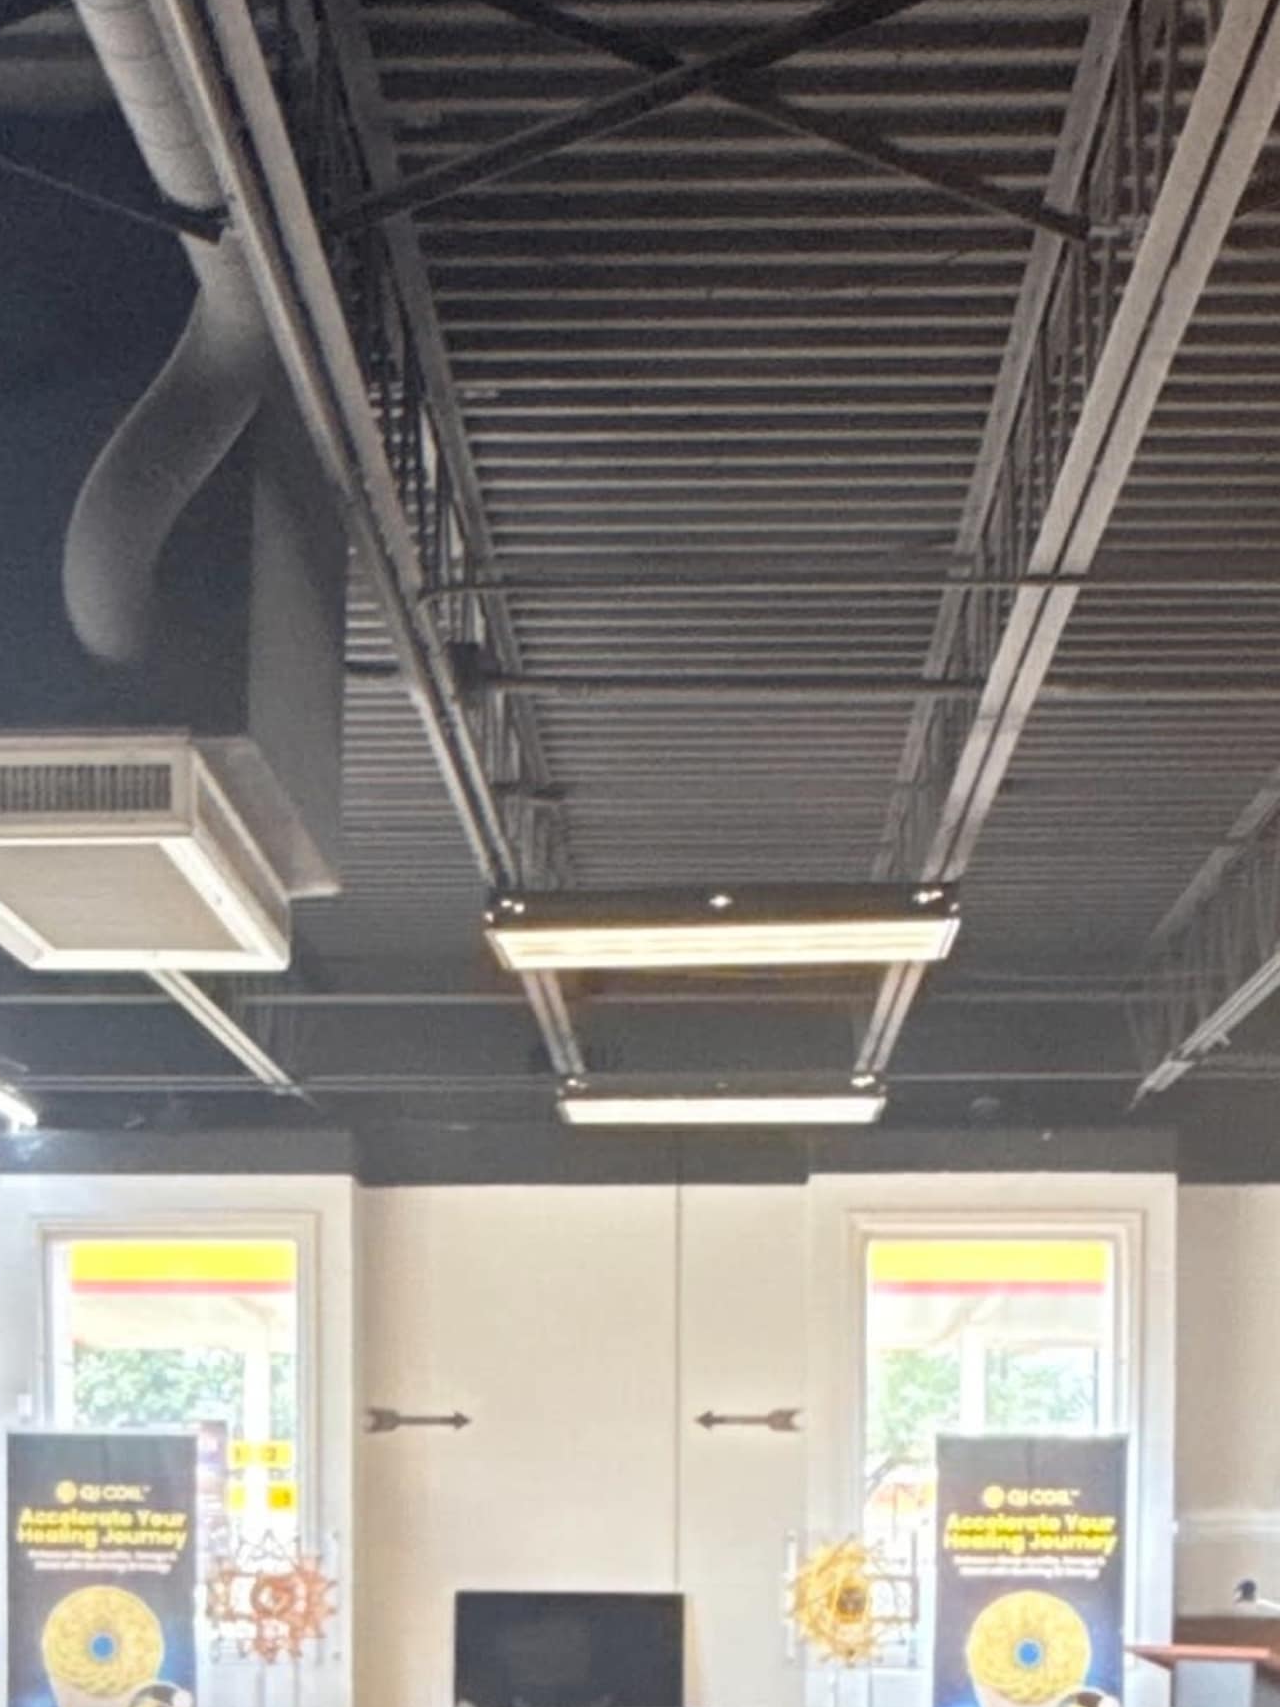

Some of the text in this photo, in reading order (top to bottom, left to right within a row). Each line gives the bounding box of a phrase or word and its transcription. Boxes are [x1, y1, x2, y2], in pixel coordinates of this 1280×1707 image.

[19, 1507, 187, 1528] Accelerate Your
[947, 1512, 1116, 1532] Accelerate Your
[16, 1526, 188, 1552] Healing Journey
[943, 1531, 1117, 1556] Healing Journey
